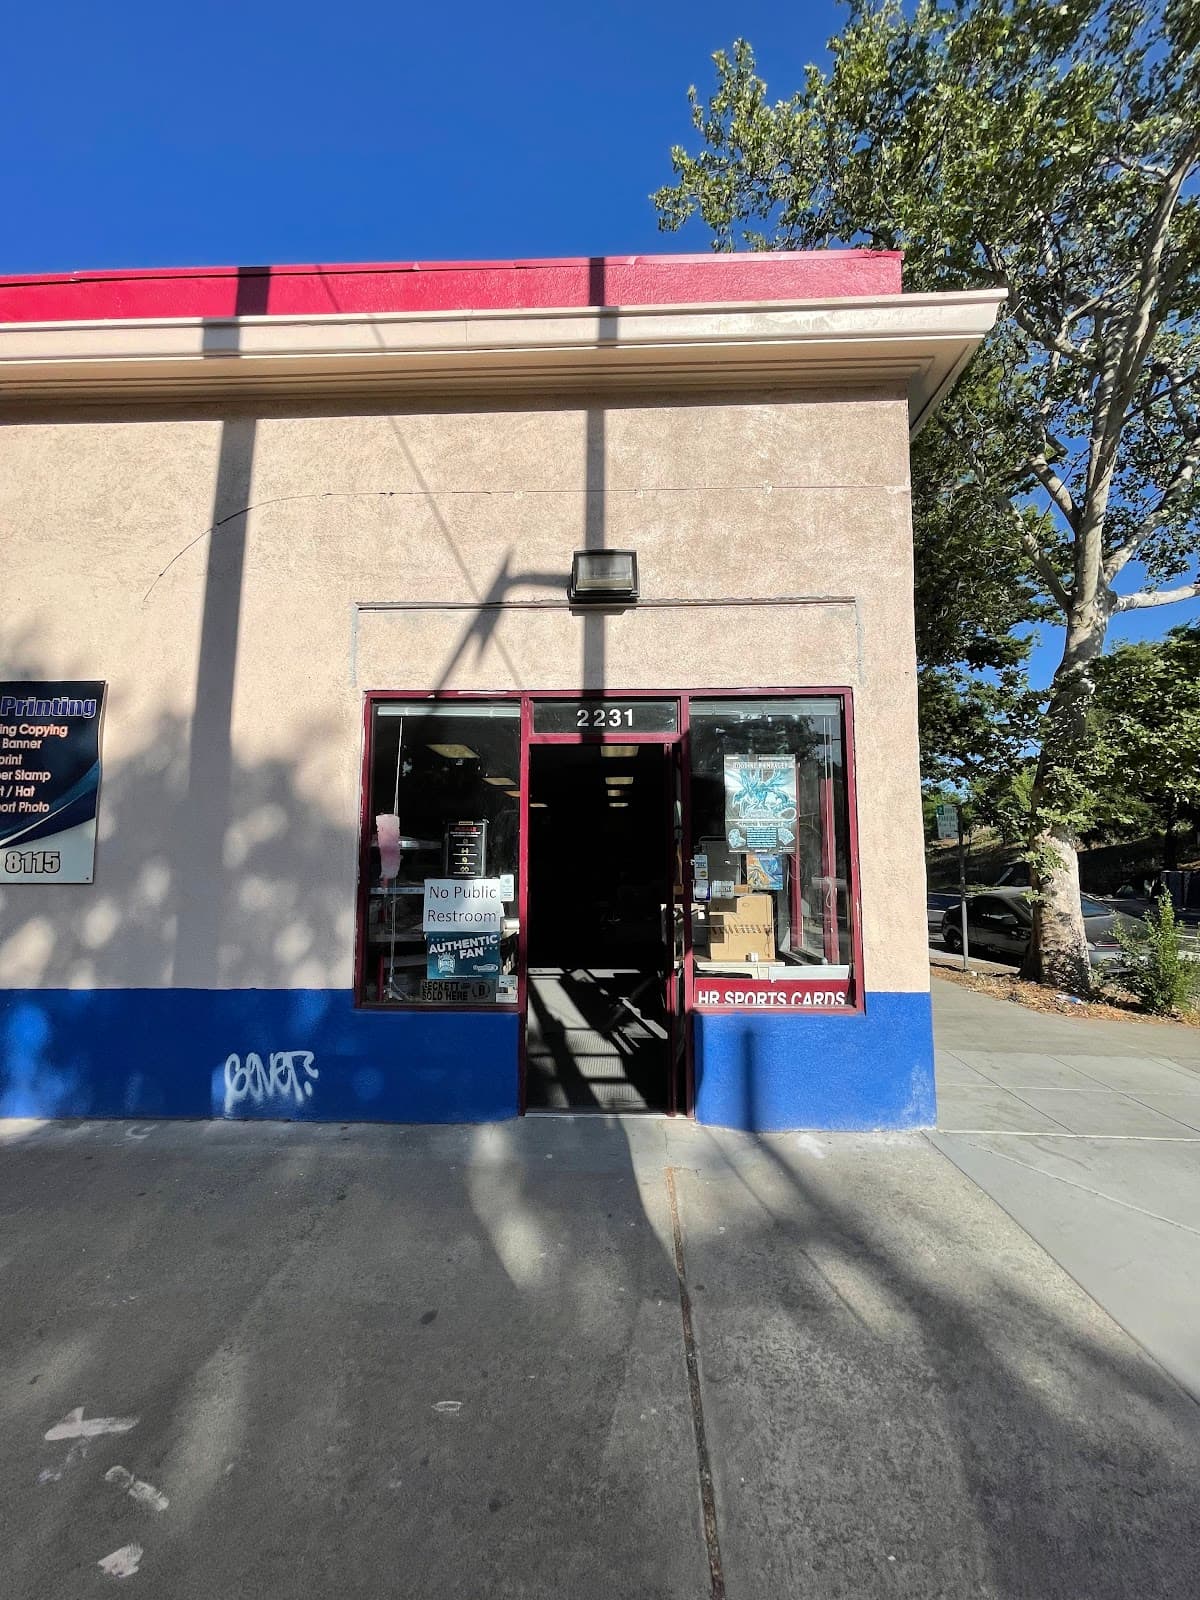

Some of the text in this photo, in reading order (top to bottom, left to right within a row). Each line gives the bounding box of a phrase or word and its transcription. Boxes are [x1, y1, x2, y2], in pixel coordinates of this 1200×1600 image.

[1, 696, 97, 719] Printing
[576, 708, 633, 727] 2231
[19, 723, 68, 738] Copying
[2, 738, 42, 749] Banner
[14, 769, 51, 782] Stamp
[15, 785, 36, 797] Hat
[18, 801, 50, 813] Photo
[5, 851, 60, 874] 8115
[429, 885, 449, 899] No
[454, 885, 497, 899] Public
[427, 909, 497, 923] Restroom
[428, 934, 498, 955] AUTHENTIC
[459, 945, 484, 960] FAN
[422, 991, 468, 1001] SOLD HERE
[698, 990, 846, 1005] HR SPORTS CARDS
